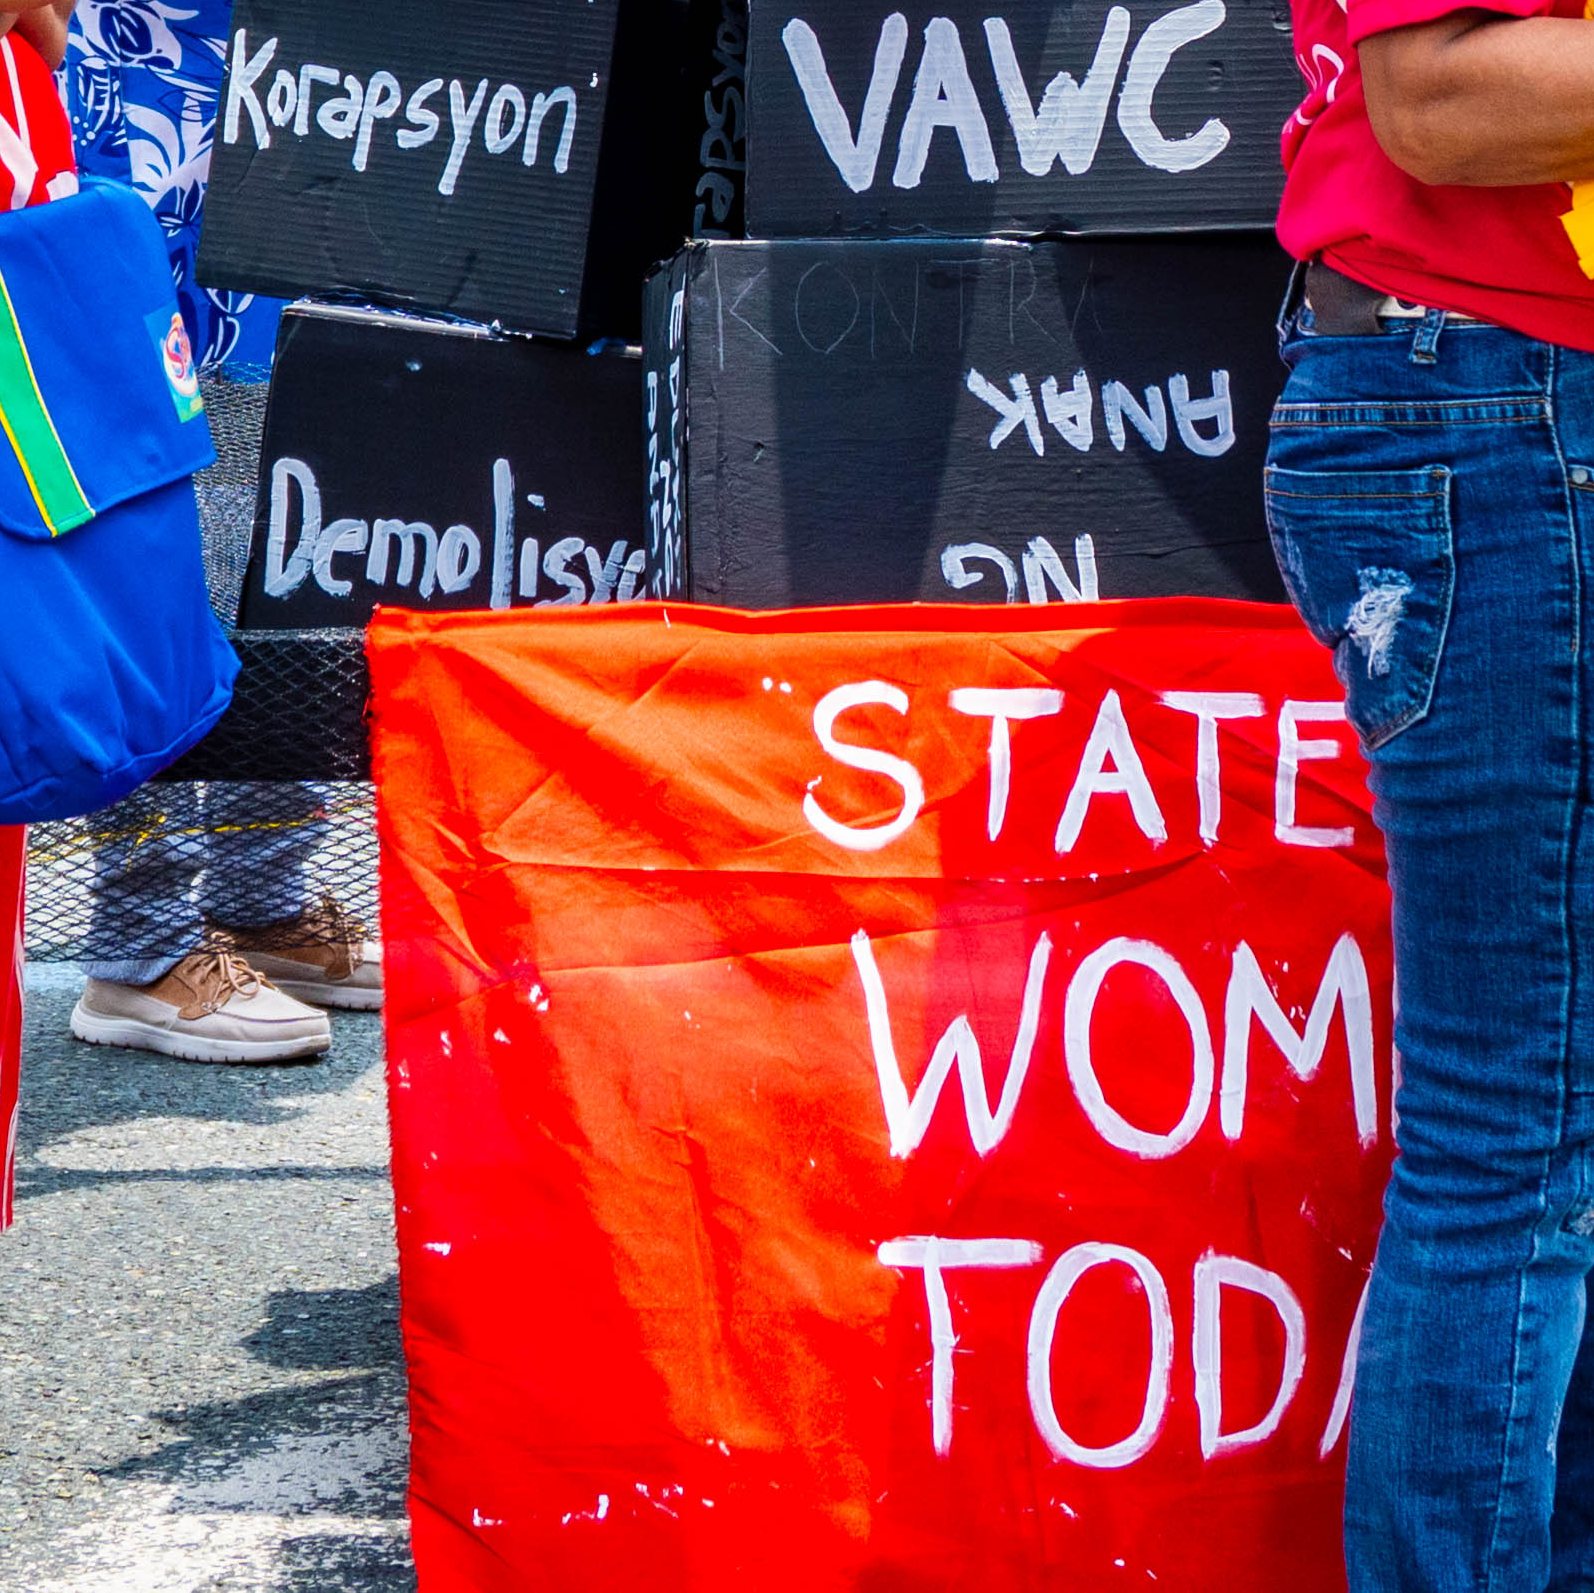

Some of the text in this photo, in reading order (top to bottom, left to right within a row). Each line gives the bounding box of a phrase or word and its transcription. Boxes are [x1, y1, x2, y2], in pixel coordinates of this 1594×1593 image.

[223, 29, 578, 196] Korapsyon
[965, 368, 1235, 457] ANAK
[802, 680, 1355, 852] STATE
